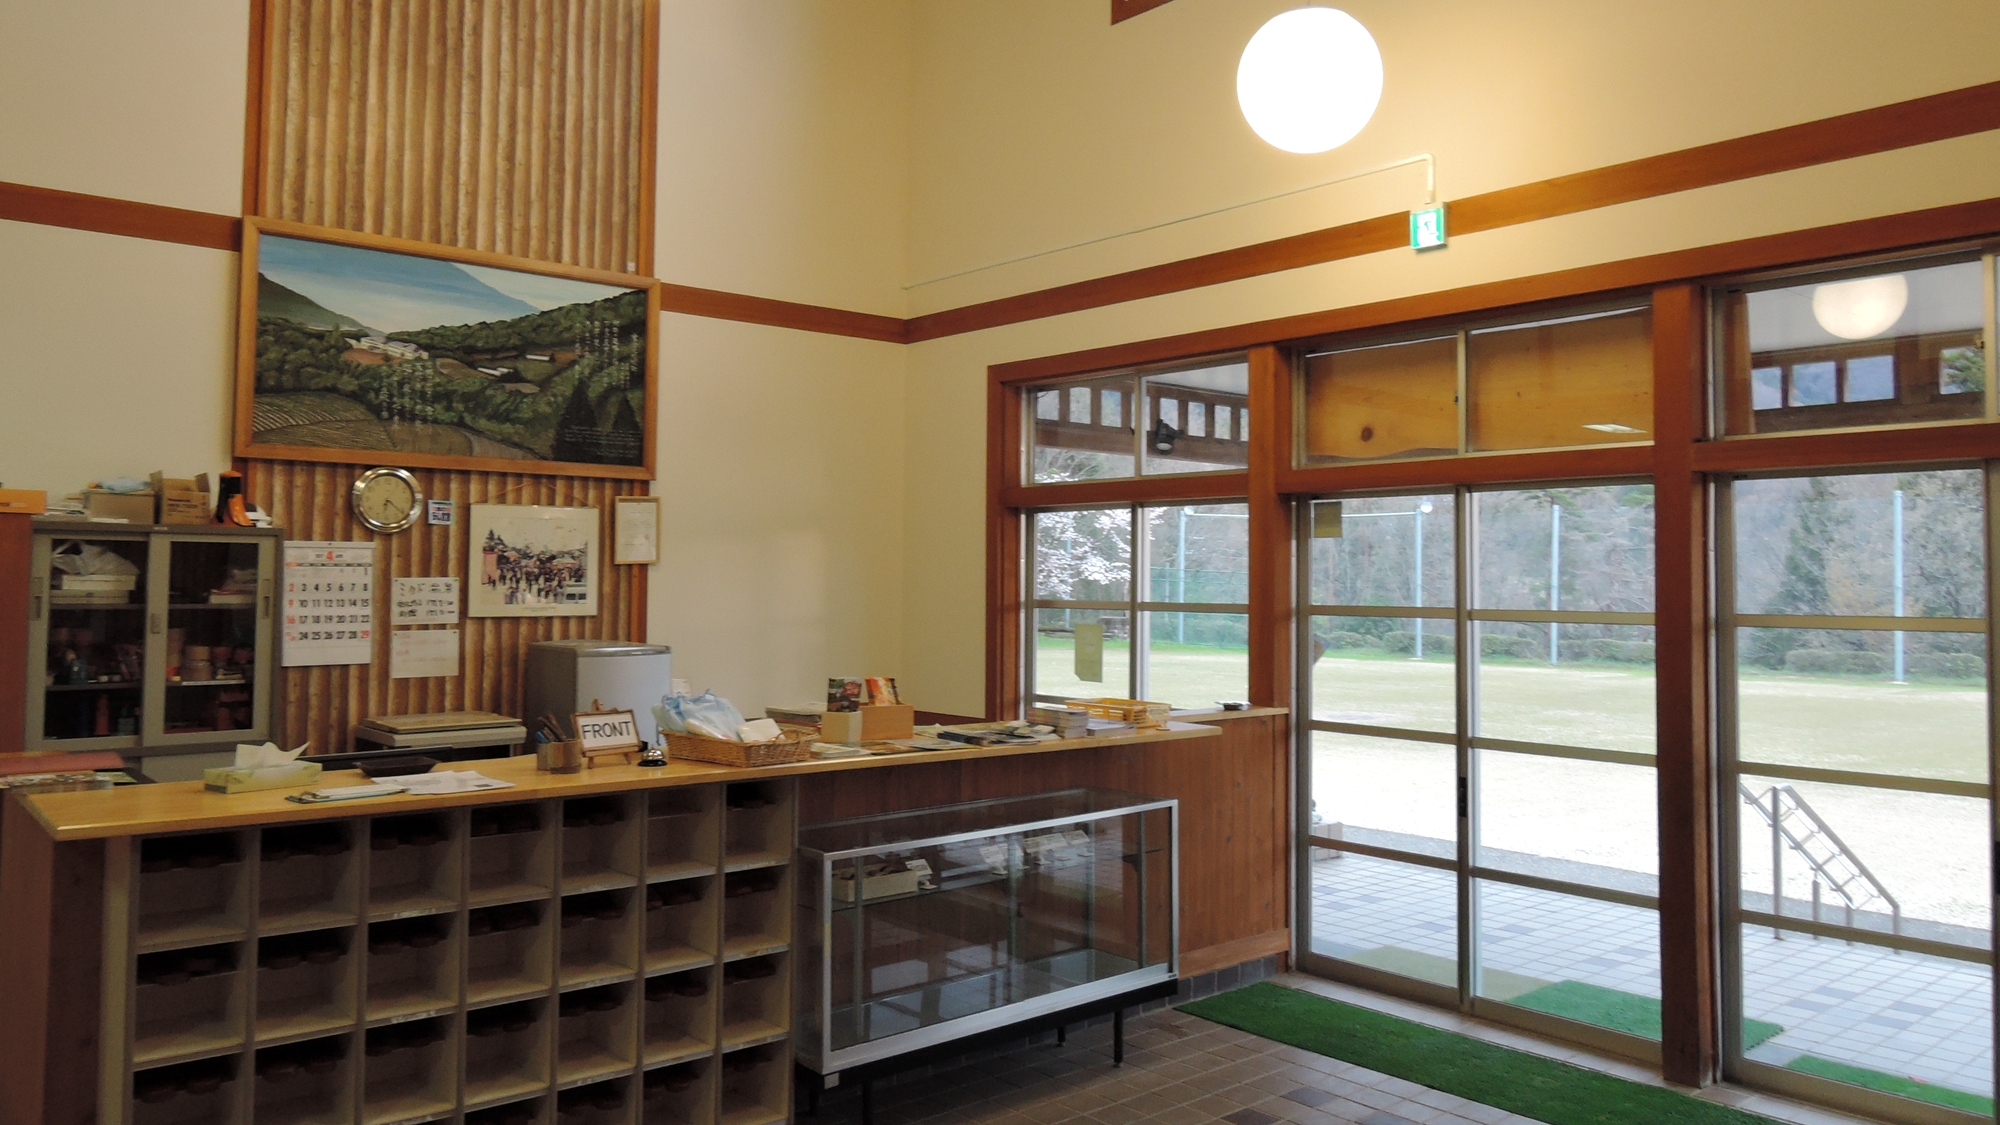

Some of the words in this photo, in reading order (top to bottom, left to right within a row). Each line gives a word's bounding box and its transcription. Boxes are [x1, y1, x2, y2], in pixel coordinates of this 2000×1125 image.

[326, 551, 334, 561] 4
[288, 583, 295, 592] 2
[301, 583, 307, 592] 3
[313, 583, 319, 592] 4
[326, 583, 332, 592] 5
[338, 583, 344, 592] 6
[350, 583, 356, 592] 7
[363, 583, 369, 592] 8
[288, 599, 294, 608] 9
[299, 599, 308, 608] 10
[312, 599, 320, 608] 11
[324, 599, 333, 608] 12
[336, 599, 345, 608] 13
[348, 599, 357, 608] 14
[361, 599, 369, 608] 15
[286, 615, 296, 624] 16
[299, 615, 308, 624] 17
[311, 615, 321, 624] 18
[324, 615, 333, 624] 19
[336, 615, 346, 624] 20
[349, 615, 358, 624] 21
[361, 615, 370, 624] 22
[299, 631, 308, 640] 24
[311, 631, 321, 640] 25
[324, 631, 333, 640] 26
[336, 631, 345, 640] 27
[348, 631, 357, 640] 28
[361, 629, 371, 639] 29
[581, 721, 631, 739] FRONT
